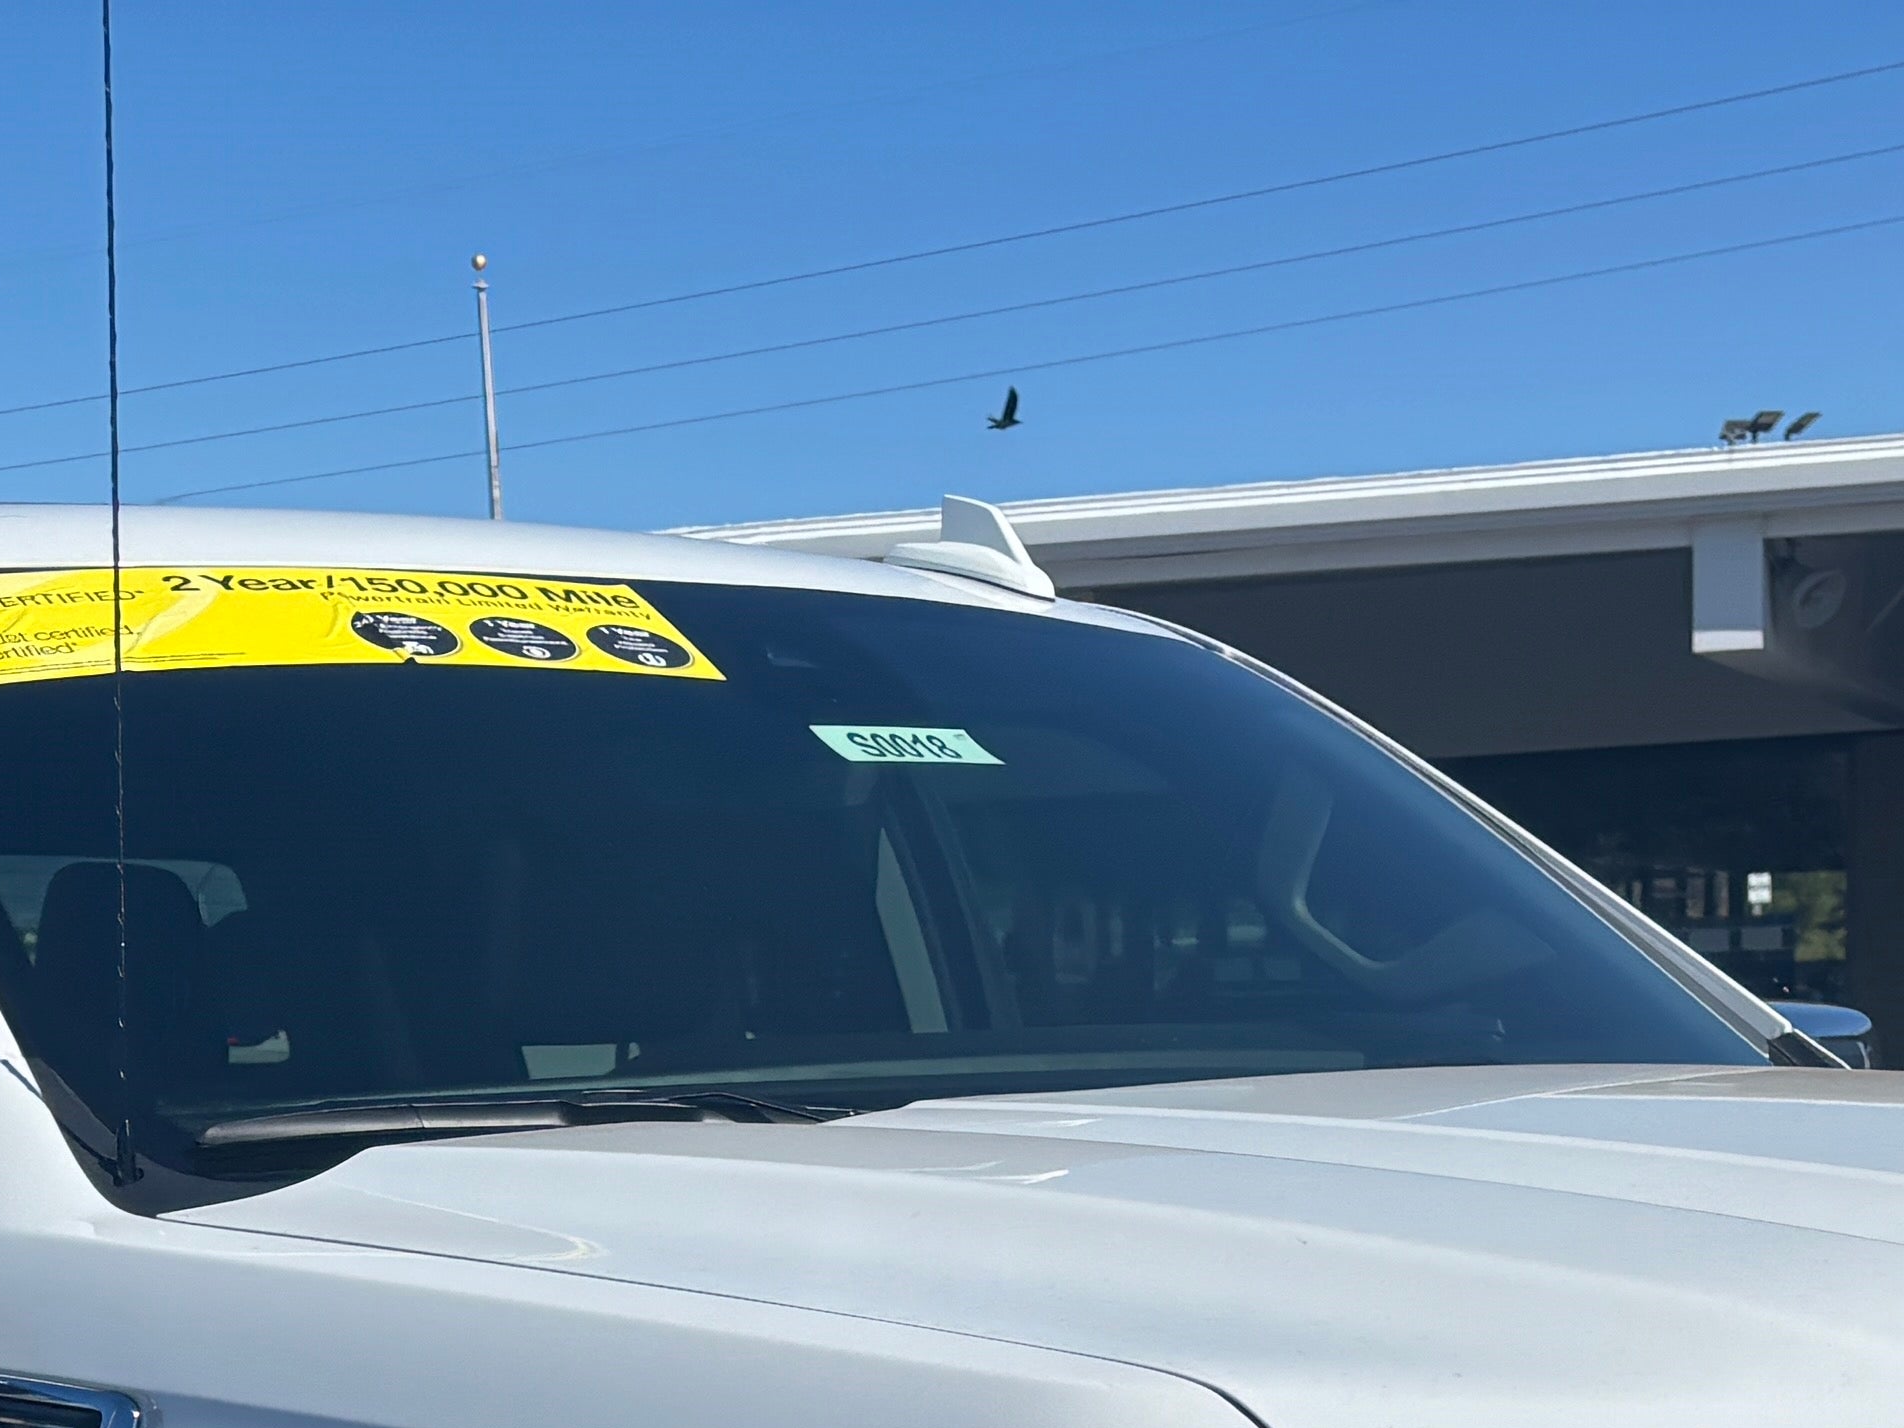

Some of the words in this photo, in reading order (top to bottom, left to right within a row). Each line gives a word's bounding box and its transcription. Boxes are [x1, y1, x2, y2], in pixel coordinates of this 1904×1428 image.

[162, 575, 200, 592] 2
[535, 585, 640, 610] Mile
[456, 597, 545, 612] Limited
[546, 601, 651, 621] Warranty
[846, 732, 963, 760] S0018
